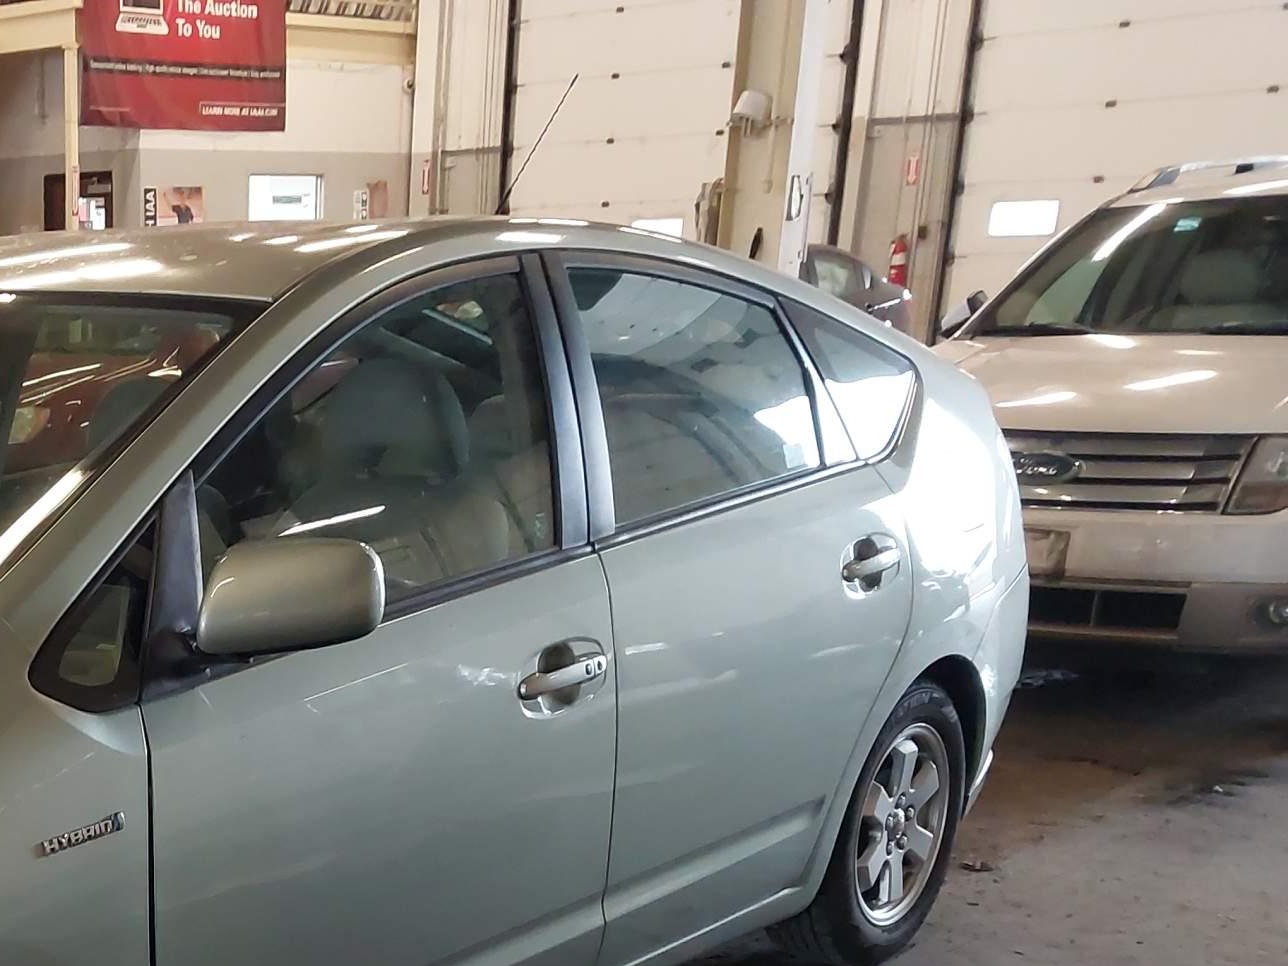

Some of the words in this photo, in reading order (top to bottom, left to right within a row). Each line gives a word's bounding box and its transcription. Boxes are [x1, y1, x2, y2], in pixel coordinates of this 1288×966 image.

[204, 0, 258, 19] Auction
[175, 17, 193, 37] To
[196, 19, 221, 39] You
[145, 191, 156, 217] IAA
[40, 818, 114, 856] HYBRID
